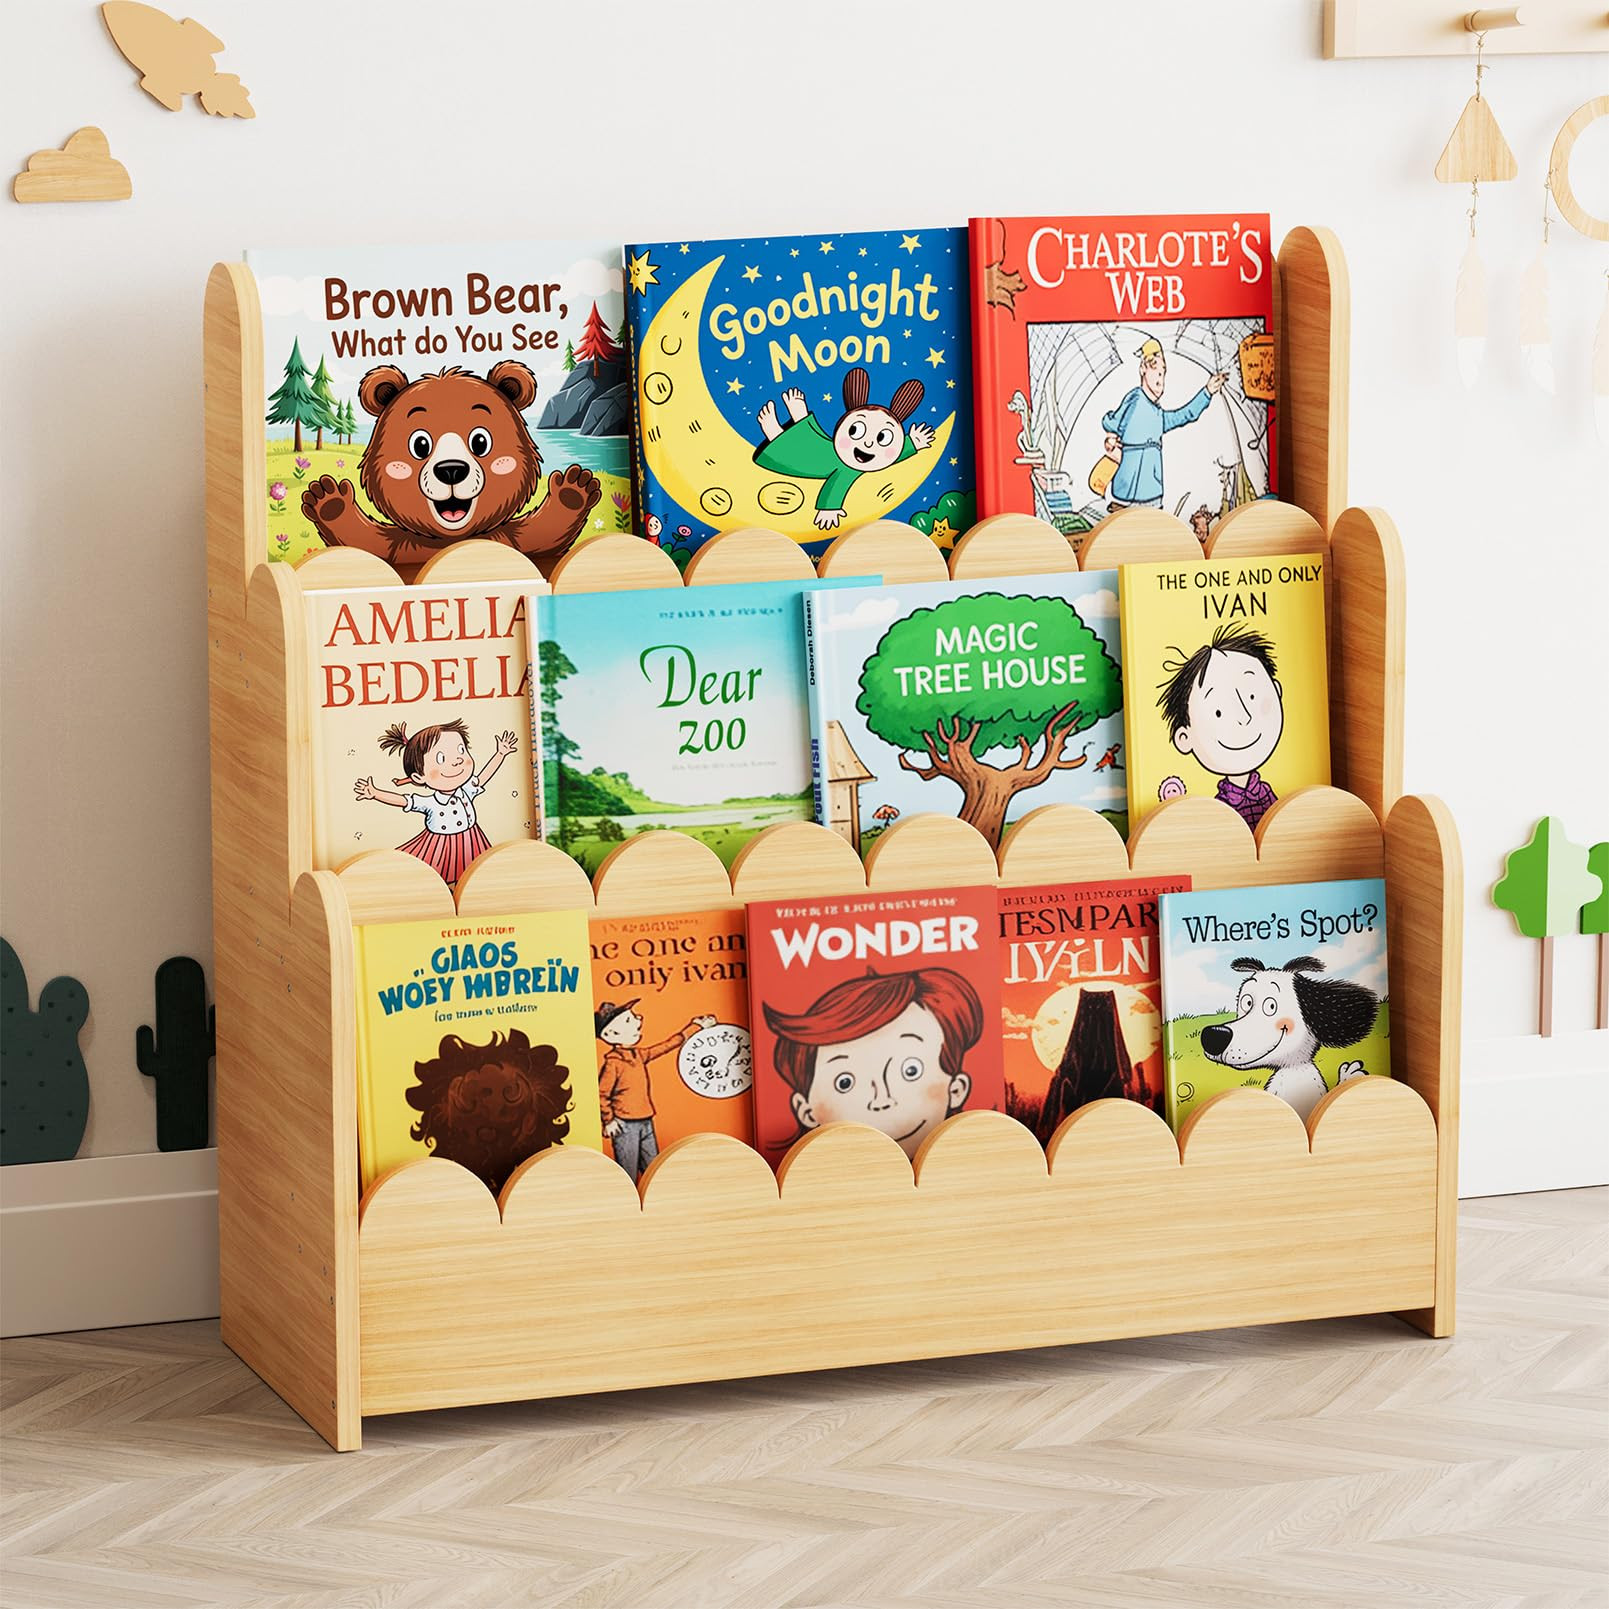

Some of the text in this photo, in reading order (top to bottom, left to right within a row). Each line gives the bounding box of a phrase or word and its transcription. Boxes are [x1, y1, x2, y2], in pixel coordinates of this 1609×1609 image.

[1027, 221, 1263, 288] CHARLOTE'S
[324, 272, 568, 320] Brown Bear,
[709, 268, 940, 360] Goodnight
[1104, 271, 1186, 314] WEB
[331, 323, 559, 358] What do You See
[768, 333, 891, 383] Moon
[1156, 564, 1322, 590] THE ONE AND ONLY
[1203, 591, 1267, 619] IVAN
[935, 621, 1039, 657] MAGIC
[639, 644, 763, 708] Dear
[808, 639, 816, 686] Deborah
[893, 654, 1087, 697] TREE HOUSE
[770, 916, 979, 971] WONDER
[1182, 903, 1378, 943] Where's Spot?
